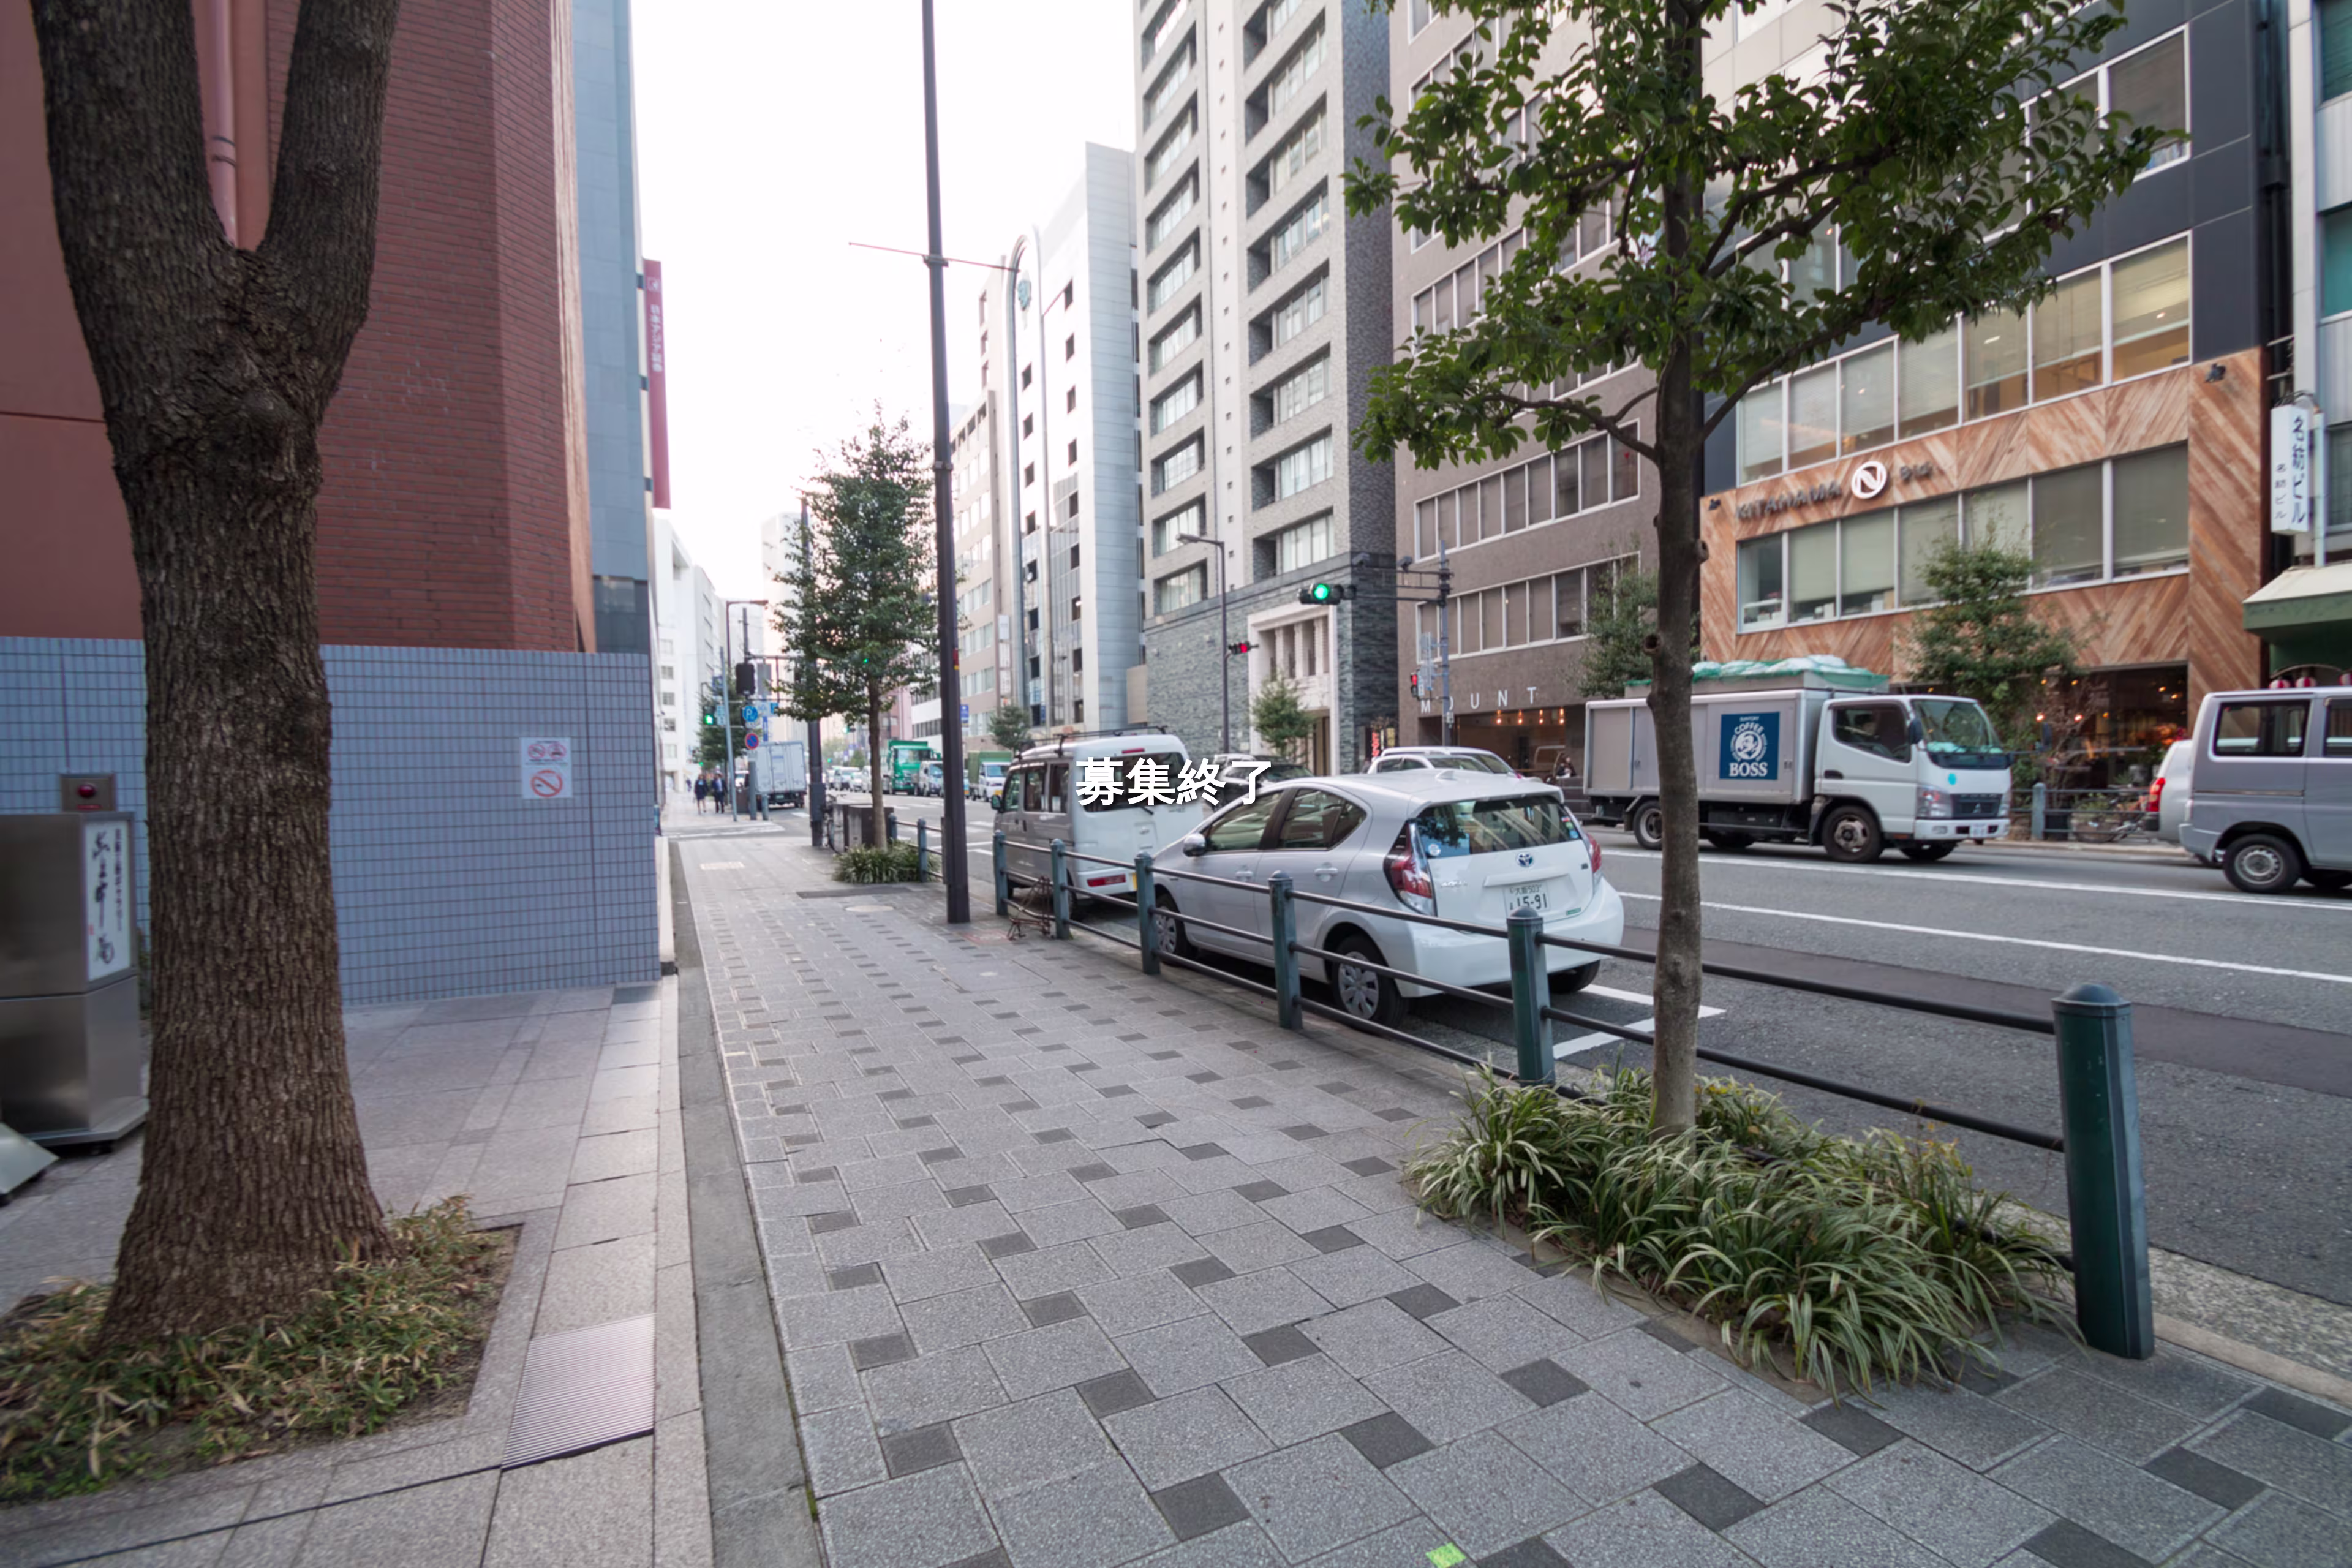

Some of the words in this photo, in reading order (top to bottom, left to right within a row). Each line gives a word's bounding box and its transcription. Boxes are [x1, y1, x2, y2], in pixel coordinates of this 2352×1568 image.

[1736, 480, 1841, 519] KITAHAMA
[1734, 722, 1765, 734] COFFEE
[1728, 761, 1768, 777] BOSS
[1517, 893, 1547, 910] 15-91
